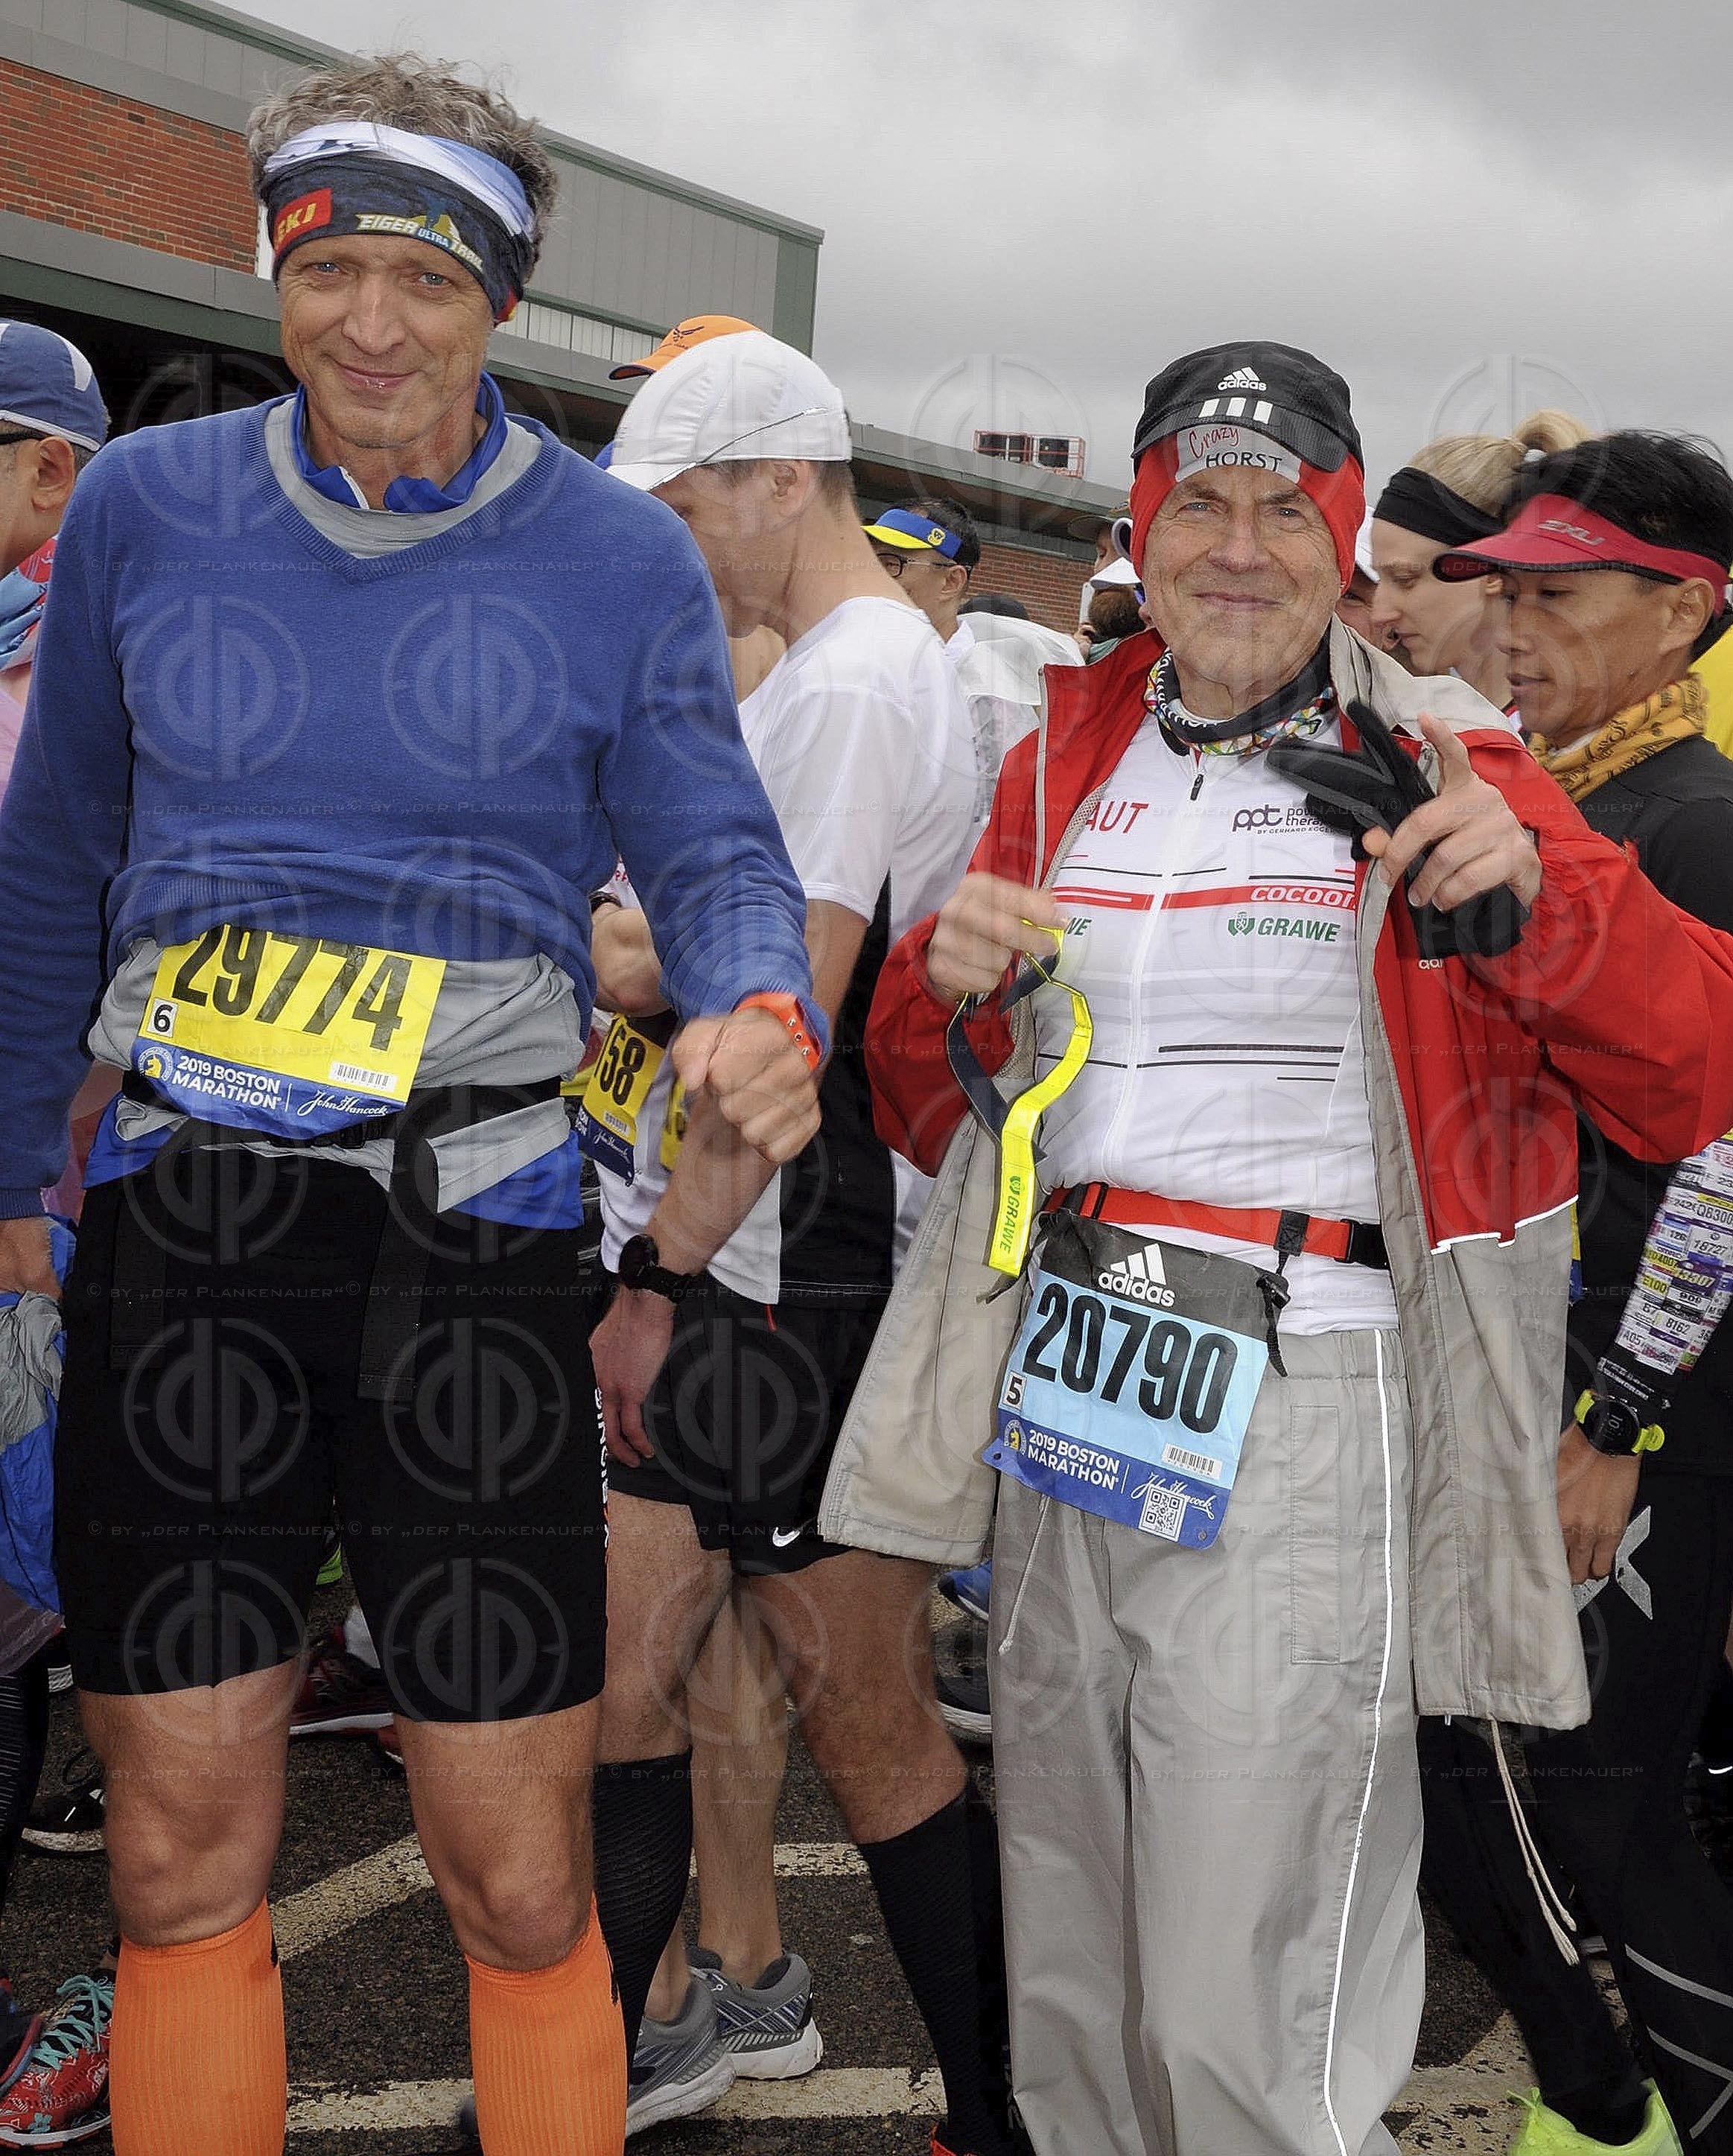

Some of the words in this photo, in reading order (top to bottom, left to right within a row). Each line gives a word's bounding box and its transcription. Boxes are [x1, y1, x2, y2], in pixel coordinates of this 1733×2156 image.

[275, 202, 317, 249] EKI
[357, 214, 418, 235] EIGER
[1217, 378, 1267, 391] adidas
[1189, 426, 1240, 459] Crazy
[1205, 451, 1283, 472] HORST
[1536, 519, 1606, 547] 2XU
[1085, 801, 1150, 834] AUT
[1258, 917, 1341, 942] GRAWE
[172, 923, 413, 1052] 29774
[153, 1004, 174, 1033] 6
[177, 1055, 212, 1078] 2019
[214, 1063, 281, 1095] BOSTON
[297, 1090, 337, 1117] John
[999, 1195, 1020, 1255] GRAWE
[1098, 1271, 1176, 1307] adidas
[1022, 1282, 1238, 1434] 20790
[1005, 1378, 1022, 1405] 5
[1028, 1429, 1056, 1452] 2019
[1057, 1439, 1121, 1475] BOSTON
